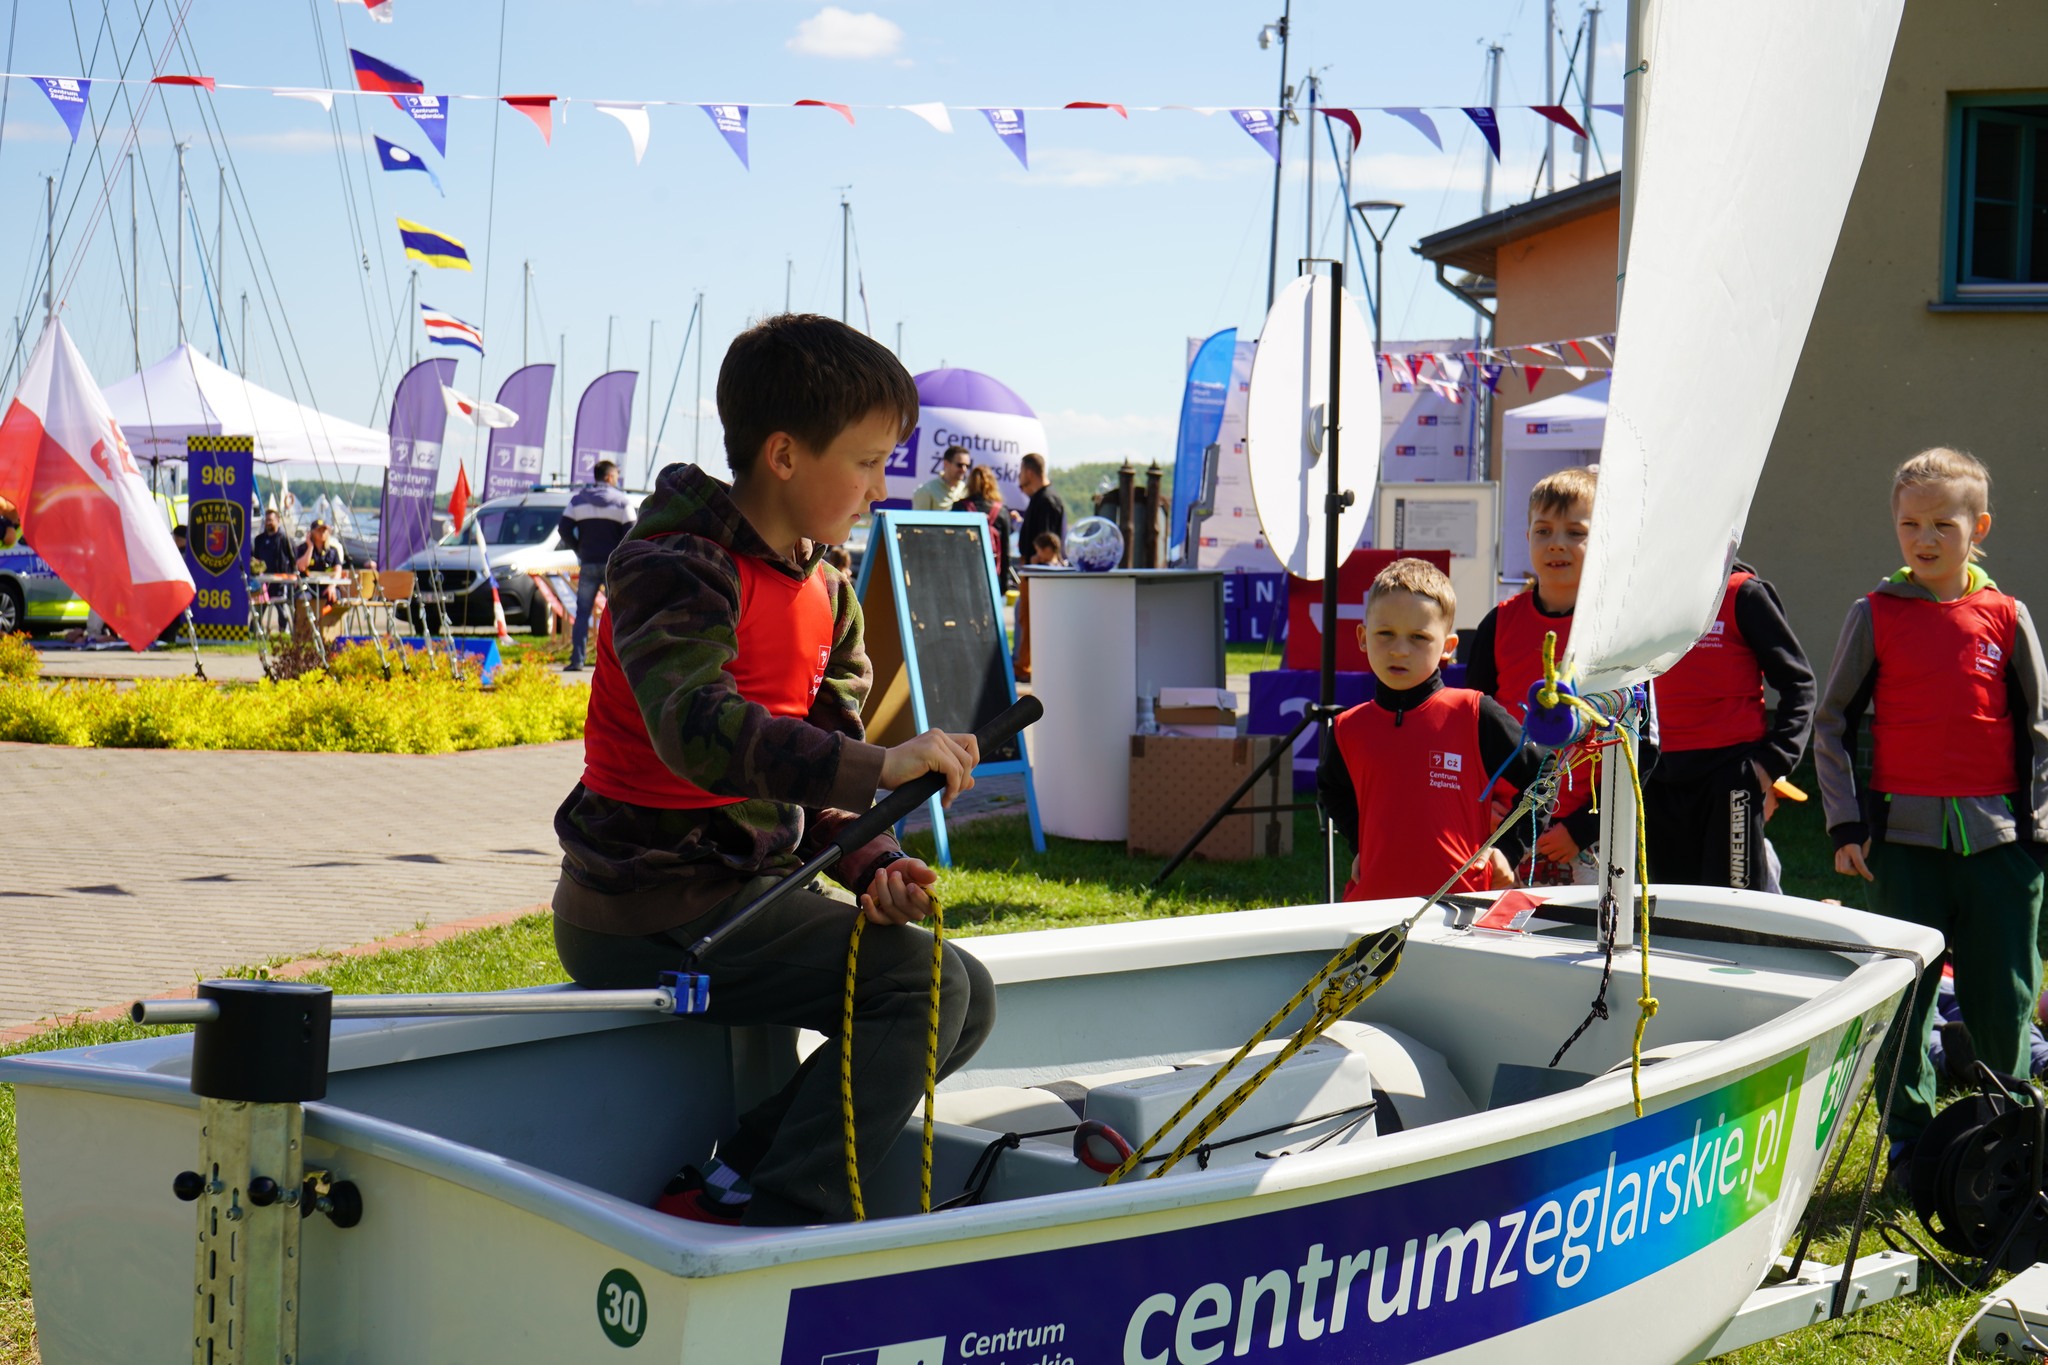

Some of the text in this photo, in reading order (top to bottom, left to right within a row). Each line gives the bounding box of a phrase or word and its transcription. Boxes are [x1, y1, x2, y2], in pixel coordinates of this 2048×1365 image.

[933, 428, 1020, 454] Centrum
[201, 466, 235, 485] 986
[388, 469, 432, 486] Centrum
[490, 475, 534, 488] Centrum
[198, 590, 231, 609] 986
[1429, 770, 1458, 781] Centrum
[1429, 778, 1461, 790] Żeglarskie
[1730, 790, 1748, 888] MINECRAFT
[1123, 1075, 1793, 1365] centrumzeglarskie.pl
[604, 1283, 640, 1334] 30
[960, 1322, 1066, 1358] Centrum
